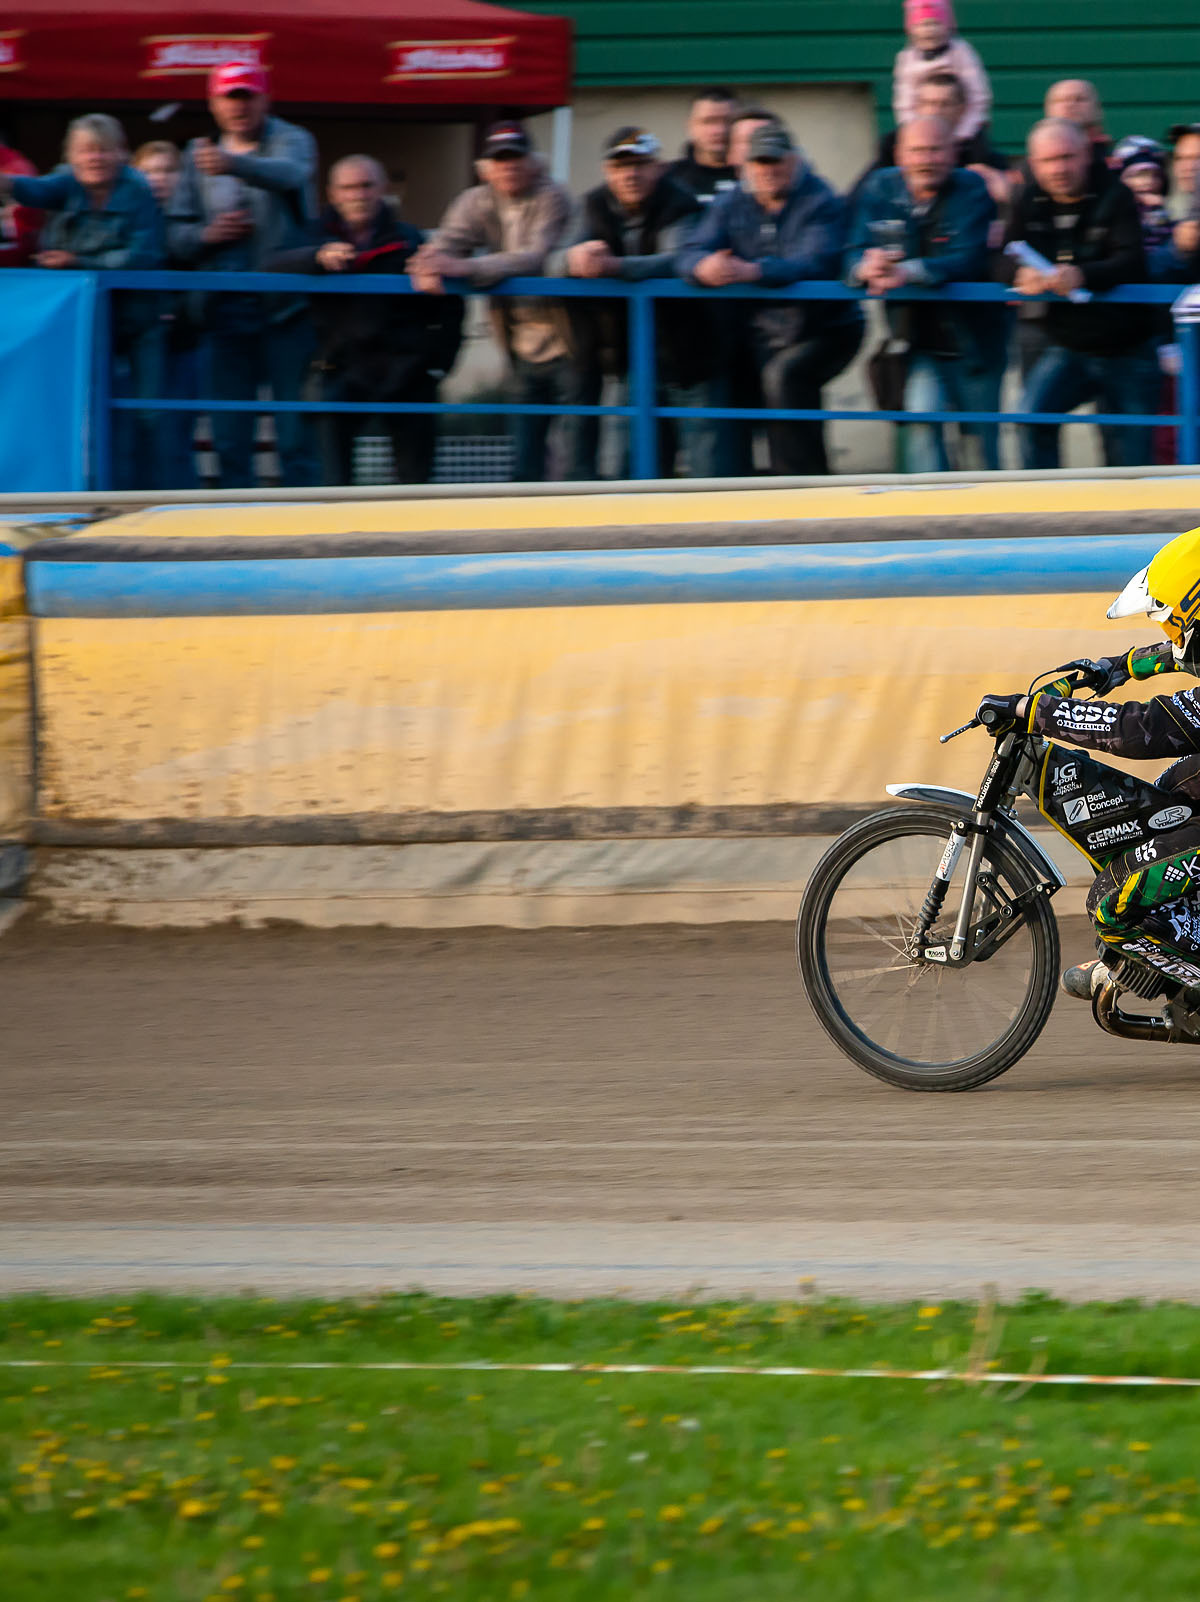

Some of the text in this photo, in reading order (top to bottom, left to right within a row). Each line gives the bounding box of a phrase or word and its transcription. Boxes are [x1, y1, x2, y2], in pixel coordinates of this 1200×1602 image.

[1052, 701, 1118, 724] ACDC
[1086, 790, 1106, 803] Best
[1089, 794, 1124, 812] Concept
[1087, 819, 1142, 844] CERMAX
